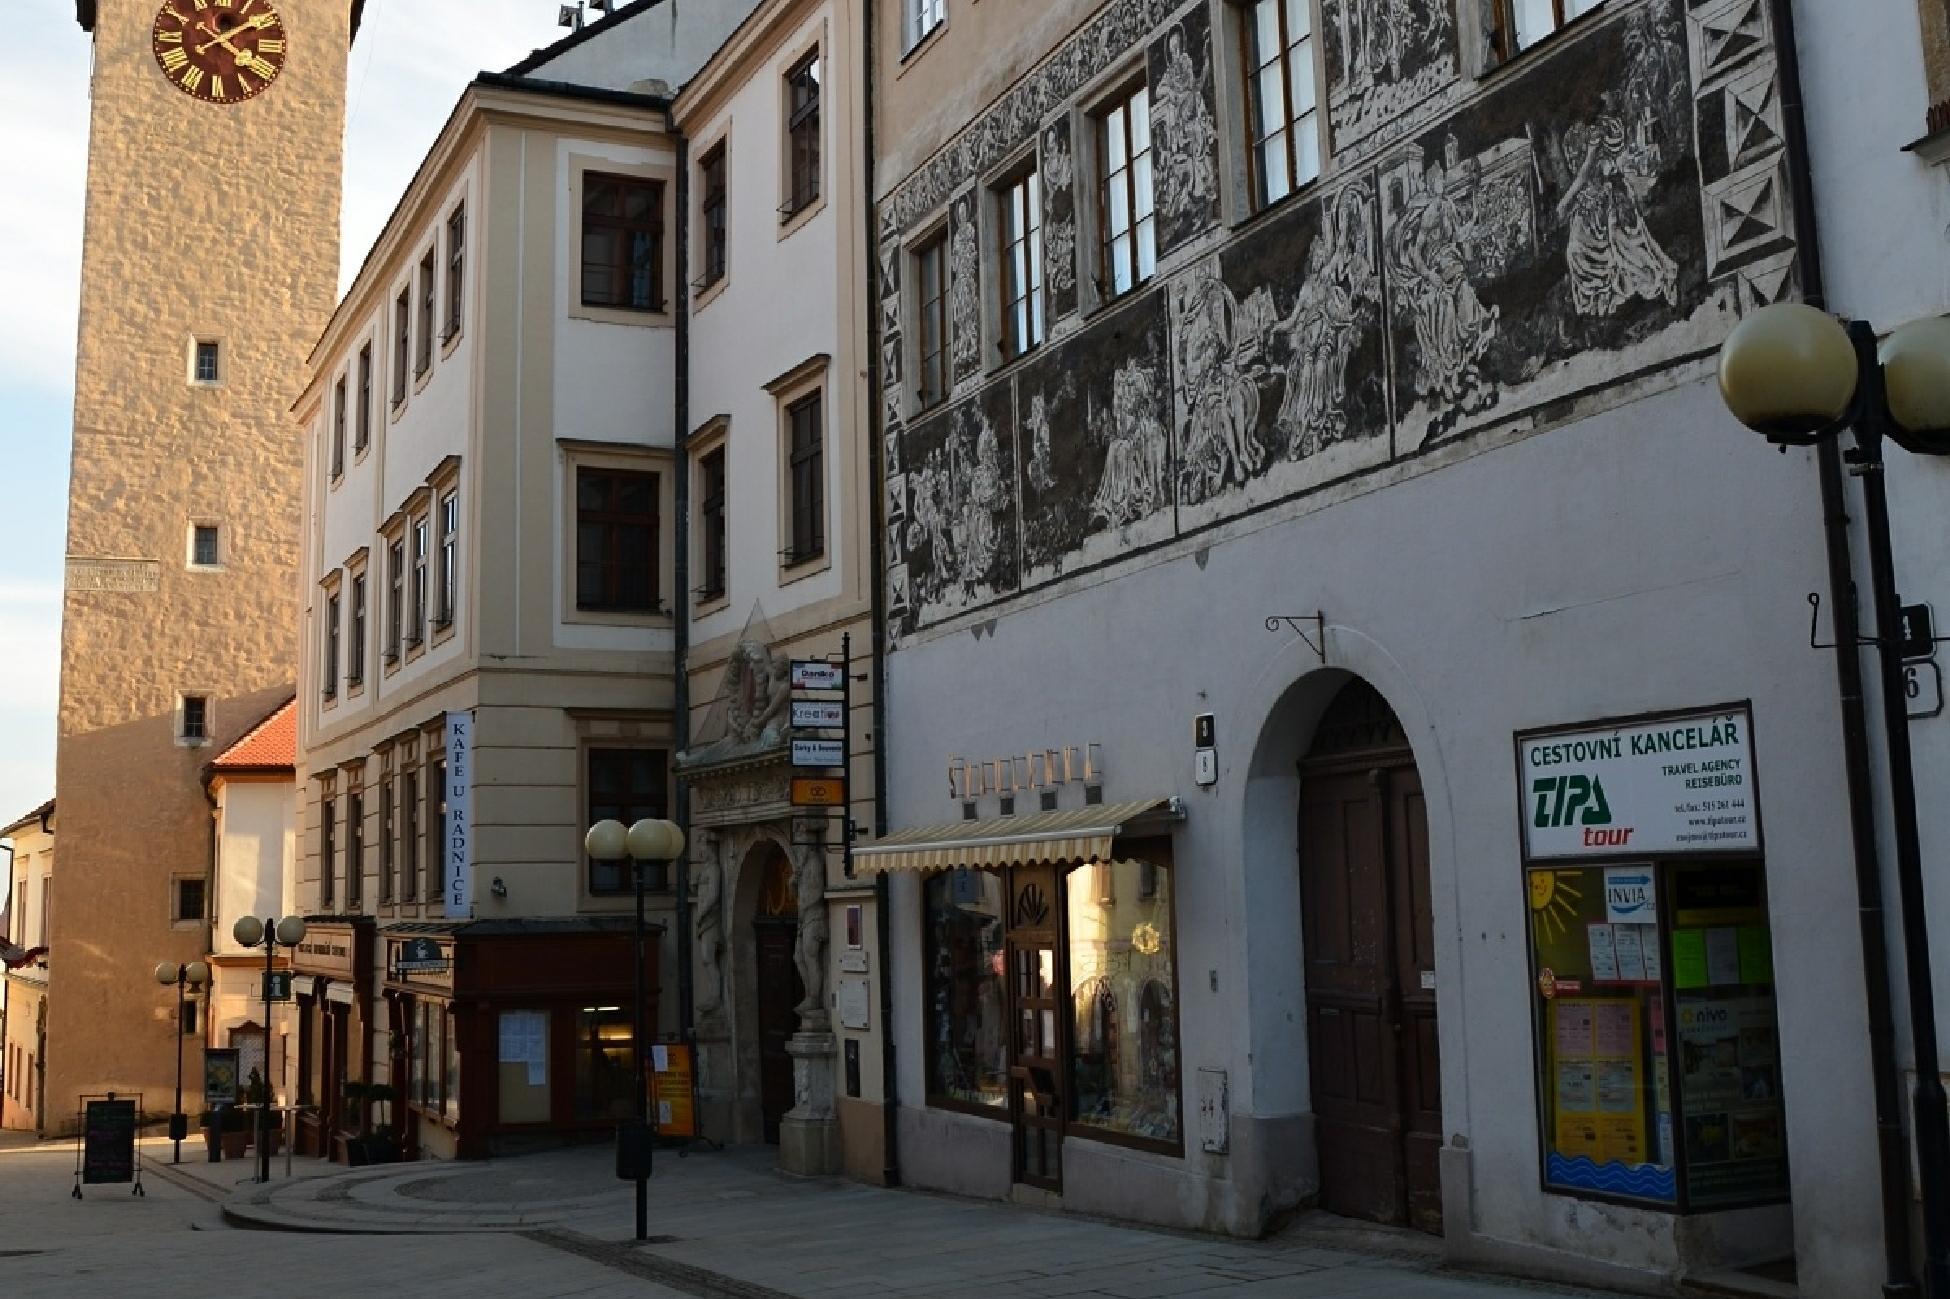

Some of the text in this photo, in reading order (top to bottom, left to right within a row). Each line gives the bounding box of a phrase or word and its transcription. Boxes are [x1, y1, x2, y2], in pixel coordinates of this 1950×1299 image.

[1530, 715, 1740, 768] CESTOVNÍ KANCELÁŘ
[1661, 758, 1742, 777] TRAVEL AGENCY
[1685, 773, 1742, 789] REISEBÜRO
[1532, 773, 1612, 828] TIPA
[452, 723, 465, 906] KAFE U RADNICE
[1583, 827, 1635, 847] tour
[1608, 886, 1646, 904] INVIA
